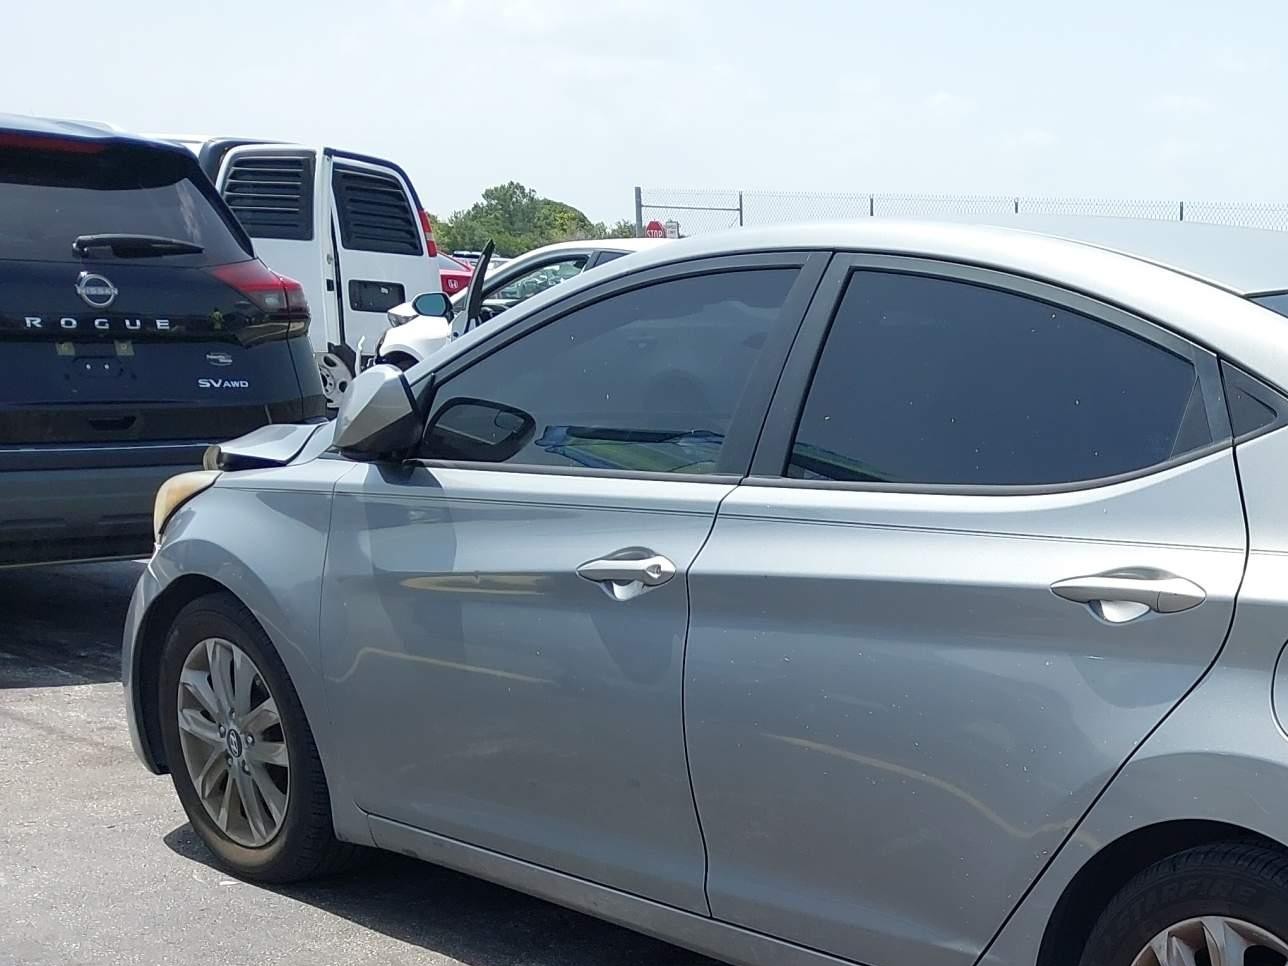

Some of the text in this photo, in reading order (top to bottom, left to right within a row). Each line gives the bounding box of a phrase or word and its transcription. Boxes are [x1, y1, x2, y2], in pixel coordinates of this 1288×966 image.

[77, 286, 118, 296] NISSAN
[24, 316, 171, 331] ROGUE
[198, 378, 249, 388] SV AWD
